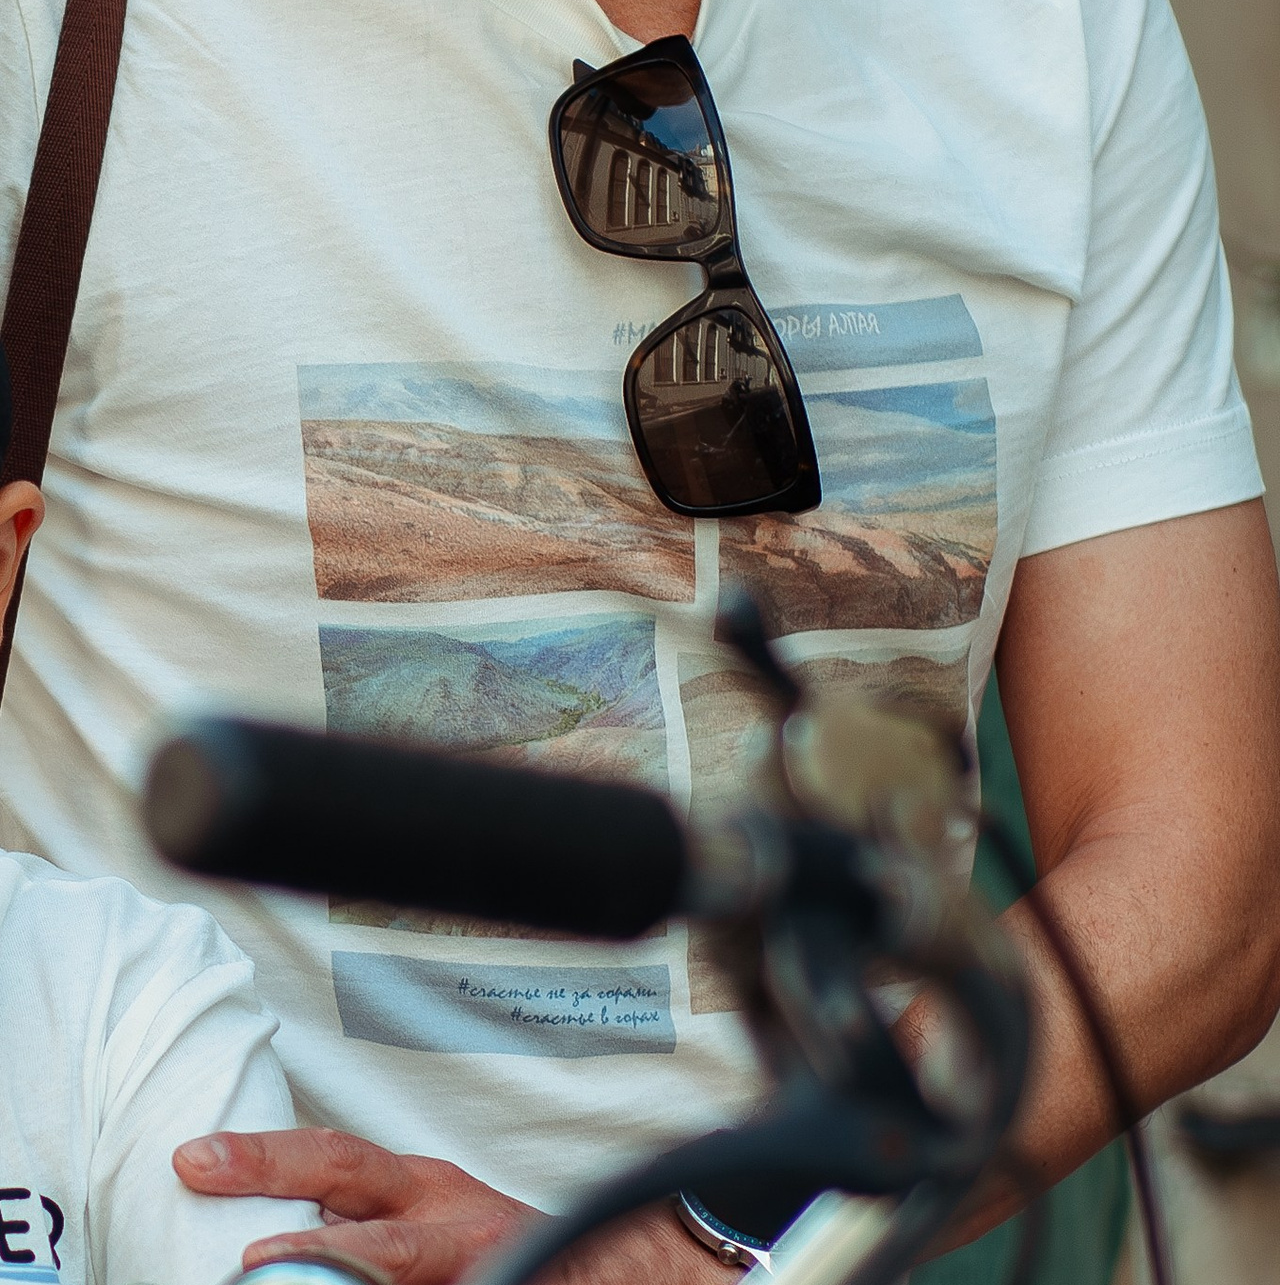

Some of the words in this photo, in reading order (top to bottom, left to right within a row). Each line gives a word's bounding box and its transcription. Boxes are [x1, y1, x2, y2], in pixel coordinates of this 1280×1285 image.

[828, 311, 881, 336] АЛТАЯ
[458, 977, 541, 1000] #счастье
[547, 987, 566, 1000] не
[572, 987, 592, 1008] за
[597, 985, 658, 1005] горами
[511, 1005, 595, 1026] #счастье
[600, 1005, 610, 1025] в
[616, 1010, 660, 1029] горах
